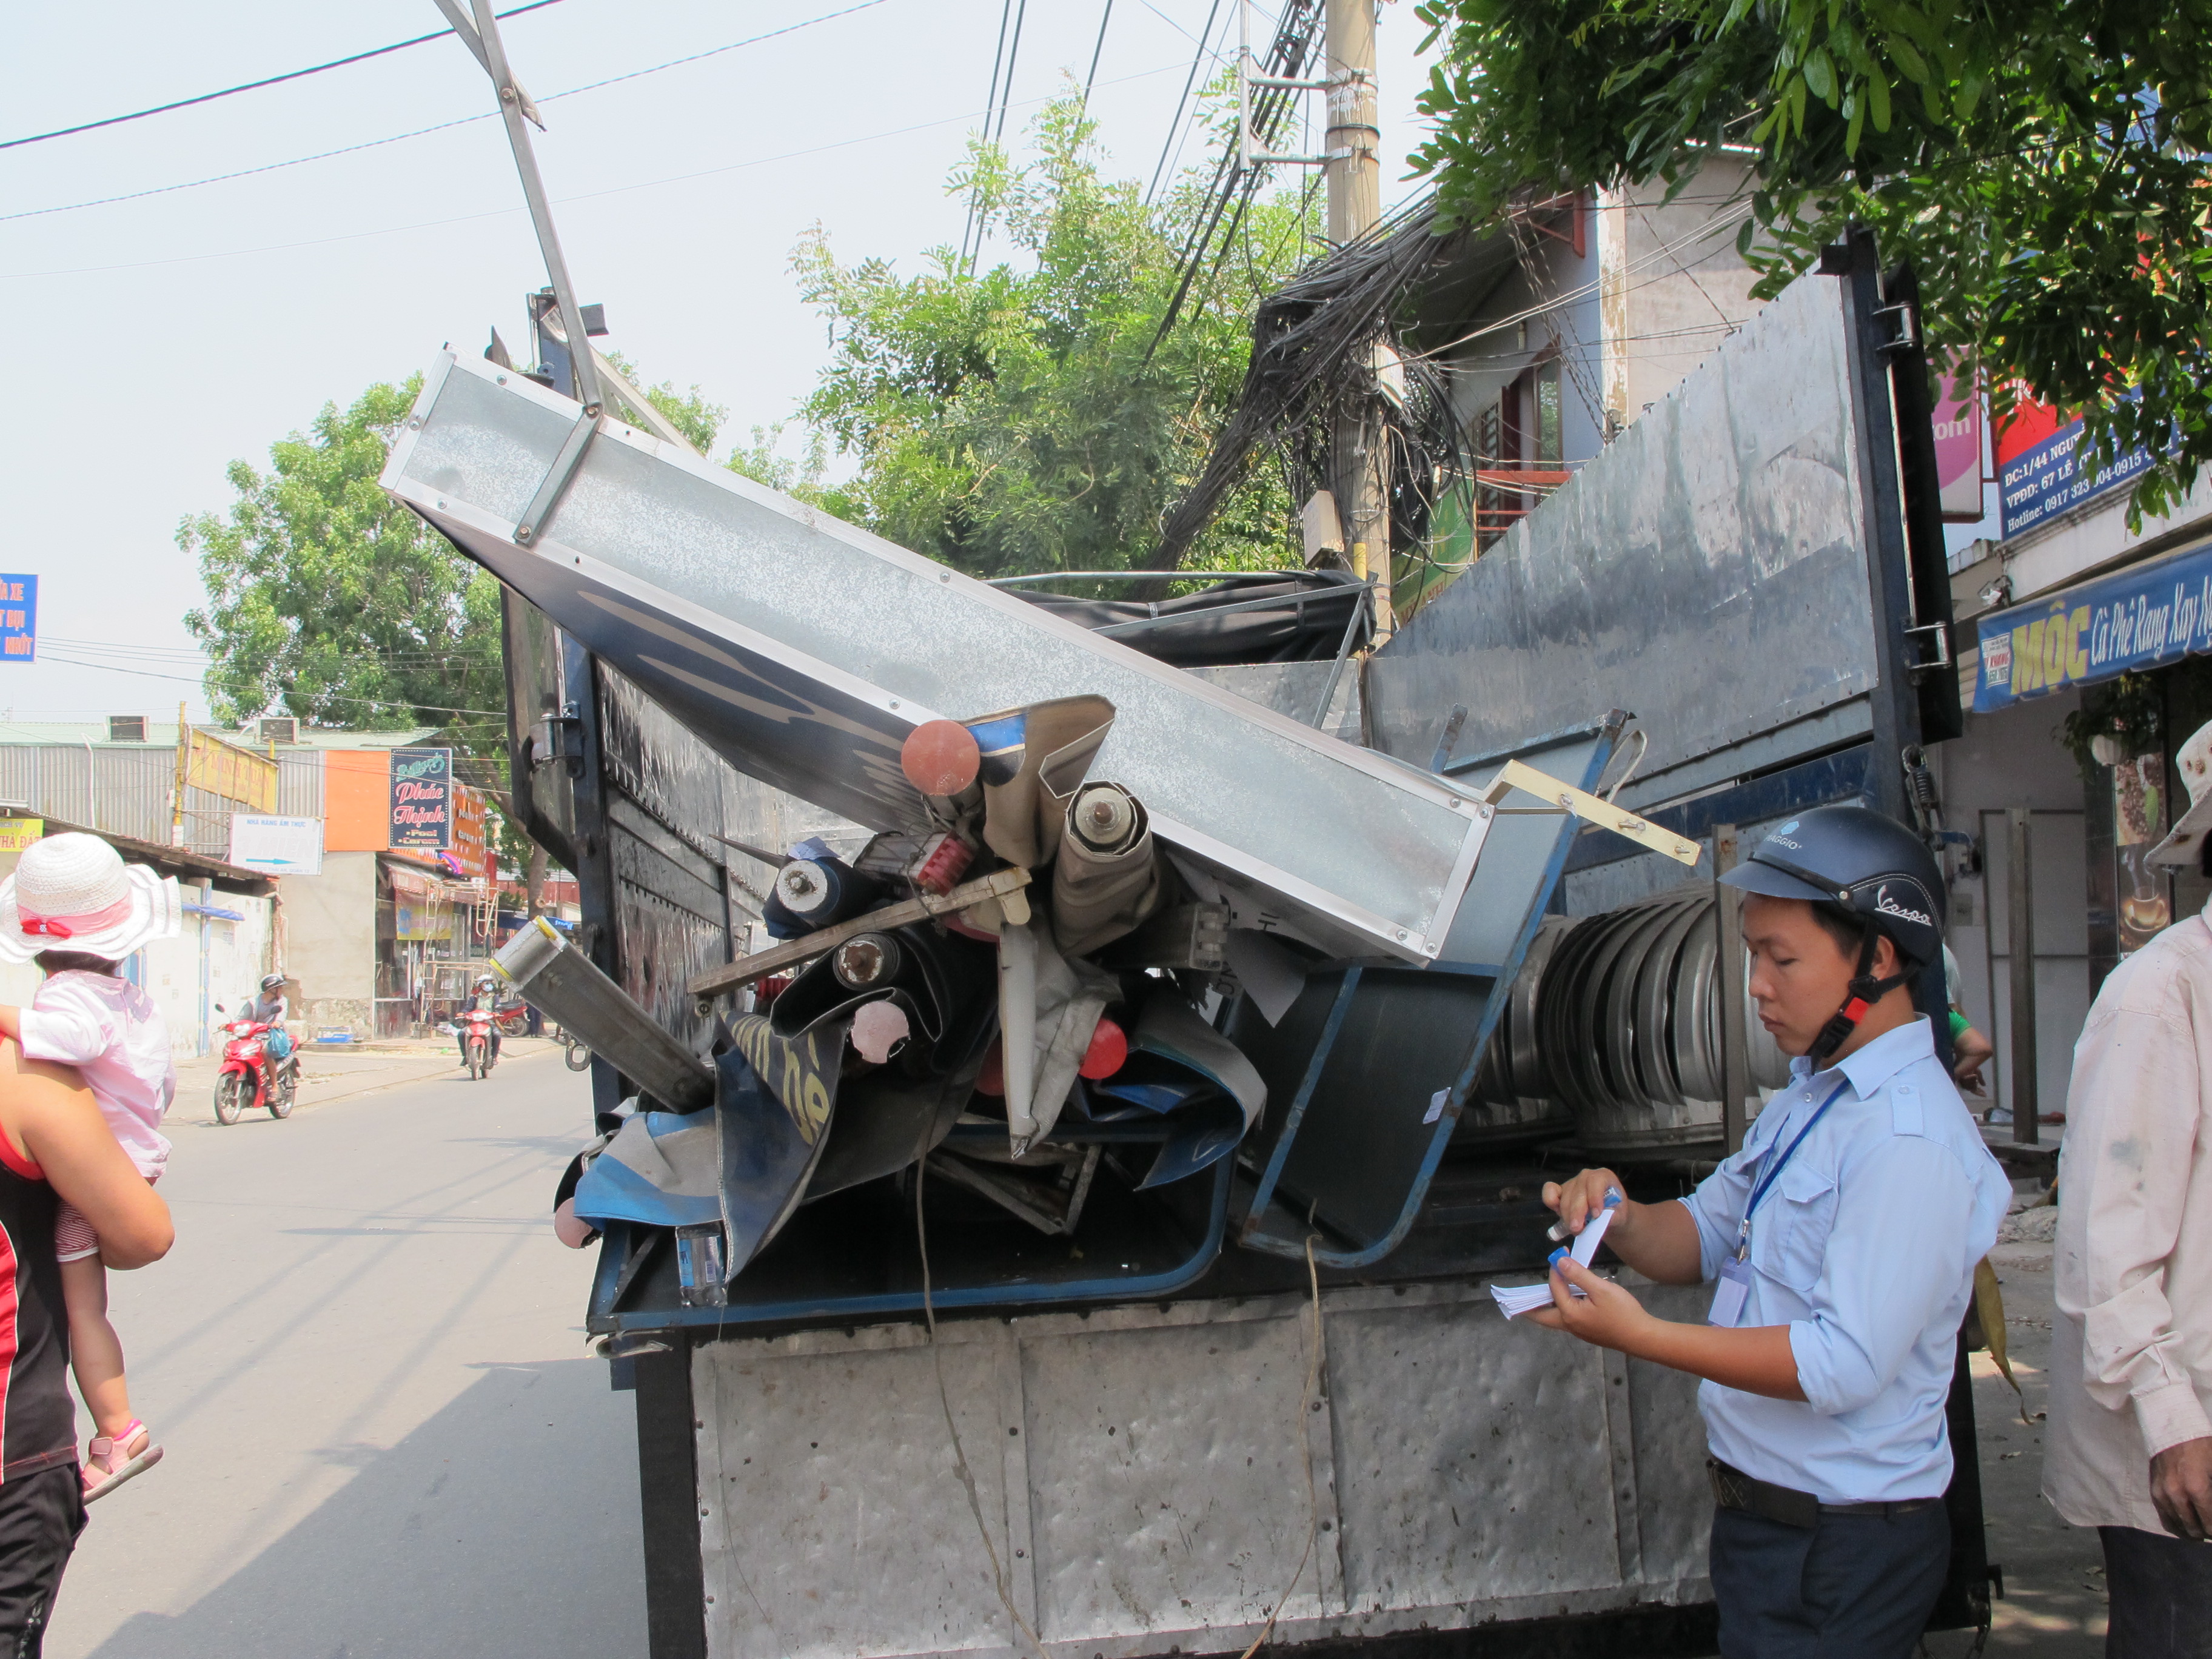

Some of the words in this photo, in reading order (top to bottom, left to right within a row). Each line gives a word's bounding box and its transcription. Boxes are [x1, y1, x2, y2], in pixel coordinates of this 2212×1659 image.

[1933, 417, 1971, 441] om
[2005, 452, 2048, 488] ĐC:1/44
[2006, 484, 2038, 508] VPĐD:
[2041, 472, 2056, 489] 67
[2058, 459, 2073, 481] LÊ
[2008, 505, 2043, 532] Hotline:
[2045, 488, 2069, 512] 0917
[2071, 478, 2090, 498] 323
[10, 583, 24, 601] XE
[7, 610, 25, 631] BỤI
[2011, 600, 2091, 695] MỘC
[2092, 606, 2109, 665] Cà
[2109, 597, 2135, 661] Phê
[2133, 594, 2170, 660] Rang
[396, 782, 444, 804] Phúc
[394, 804, 446, 828] Thịnh
[1874, 885, 1932, 927] Vespa
